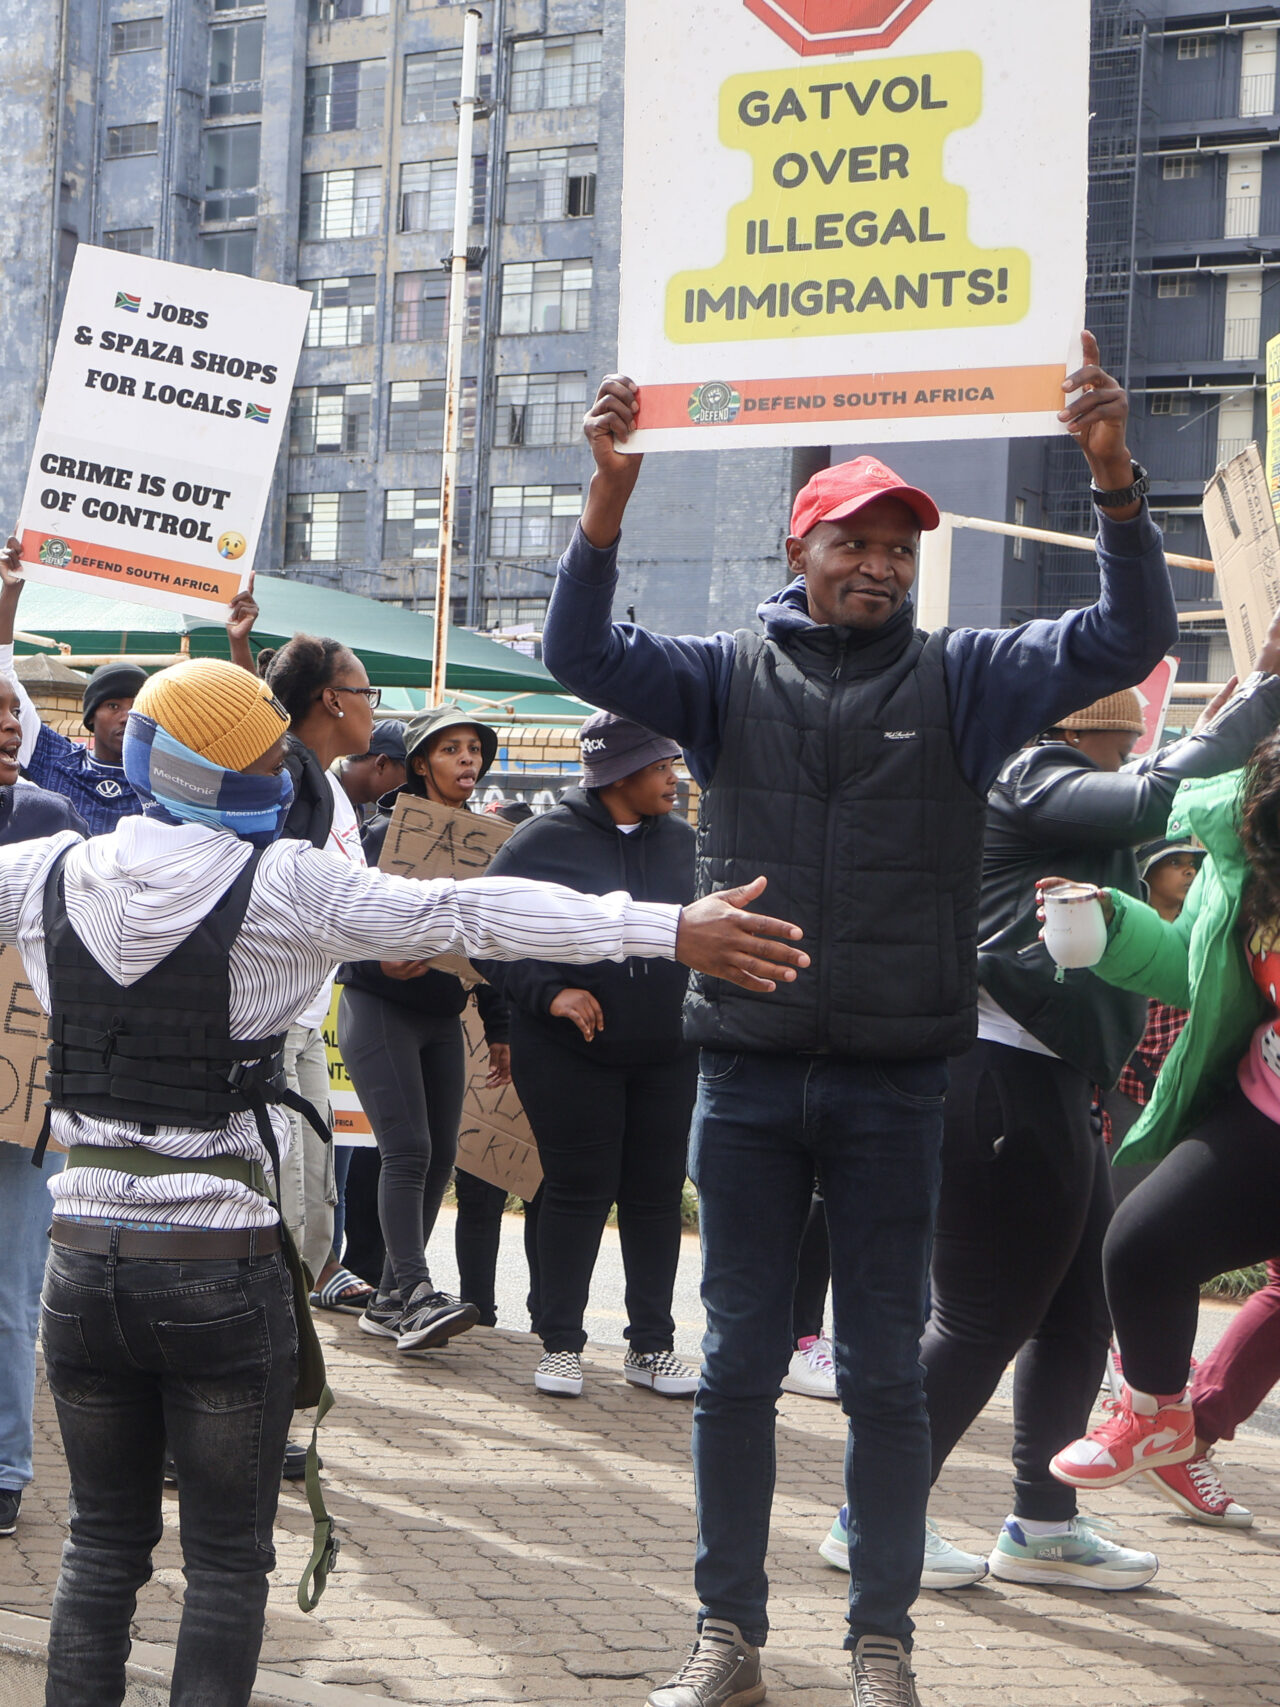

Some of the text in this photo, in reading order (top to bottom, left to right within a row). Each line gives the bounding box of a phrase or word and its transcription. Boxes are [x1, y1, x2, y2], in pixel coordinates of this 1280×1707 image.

[738, 74, 948, 126] GATVOL
[772, 143, 909, 189] OVER
[746, 206, 946, 255] ILLEGAL
[147, 301, 209, 329] JOBS
[684, 267, 1008, 323] IMMIGRANTS!
[74, 325, 278, 385] & SPAZA SHOPS
[85, 368, 243, 419] FOR LOCALS
[700, 407, 729, 421] DEFEND
[744, 386, 995, 413] DEFEND SOUTH AFRICA
[40, 453, 231, 511] CRIME IS OUT
[40, 488, 214, 544] OF CONTROL
[72, 554, 220, 594] DEFEND SOUTH AFRICA
[153, 766, 216, 796] Medtronic
[394, 807, 504, 868] PAS
[334, 1118, 354, 1127] FRICA
